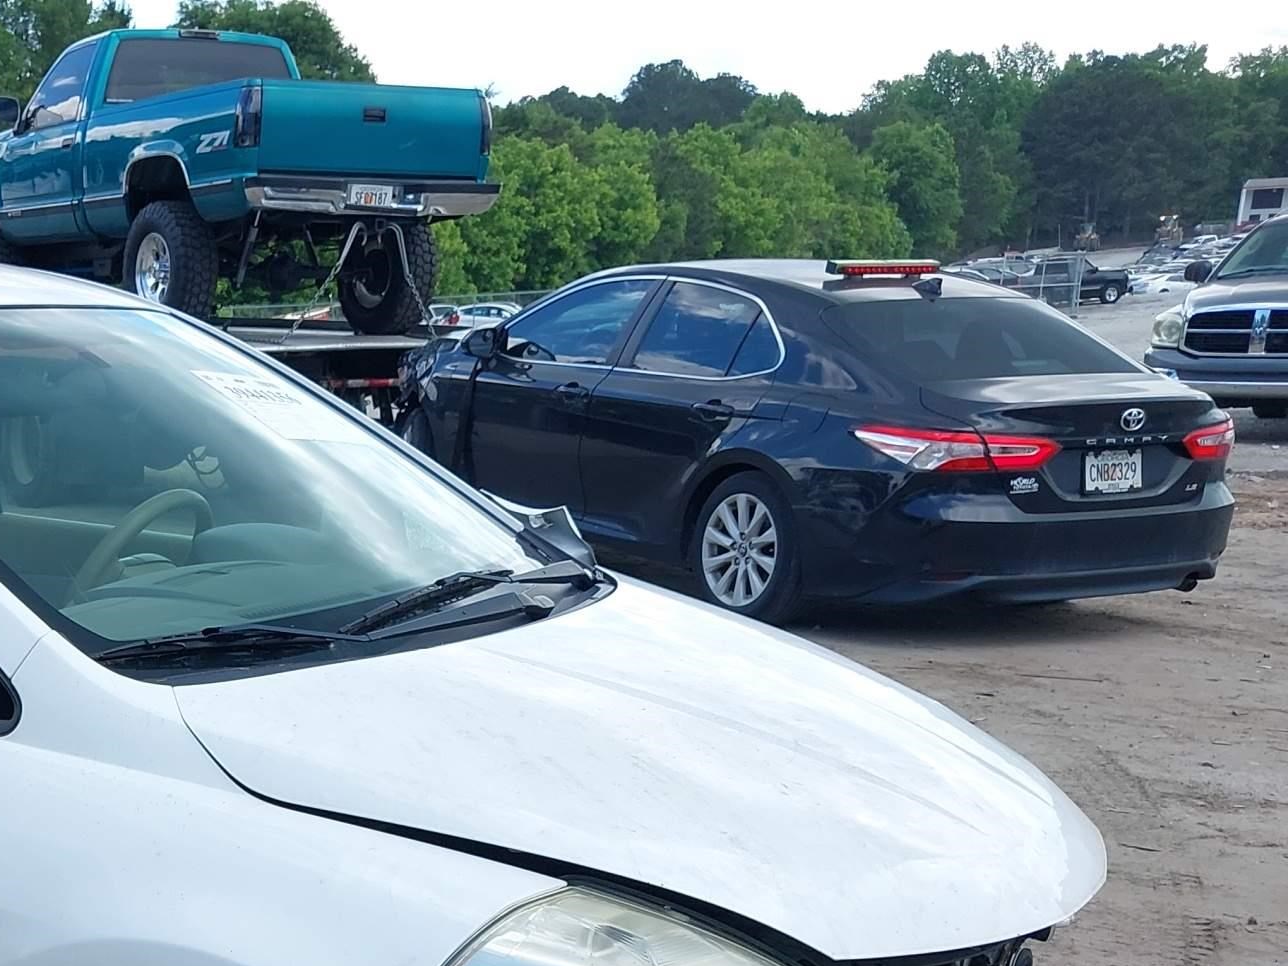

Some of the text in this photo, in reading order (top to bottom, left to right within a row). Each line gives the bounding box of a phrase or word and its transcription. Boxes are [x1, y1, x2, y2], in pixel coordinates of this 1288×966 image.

[195, 130, 230, 154] Z71
[1086, 435, 1168, 445] CAMRY
[1089, 461, 1137, 482] CNB2329
